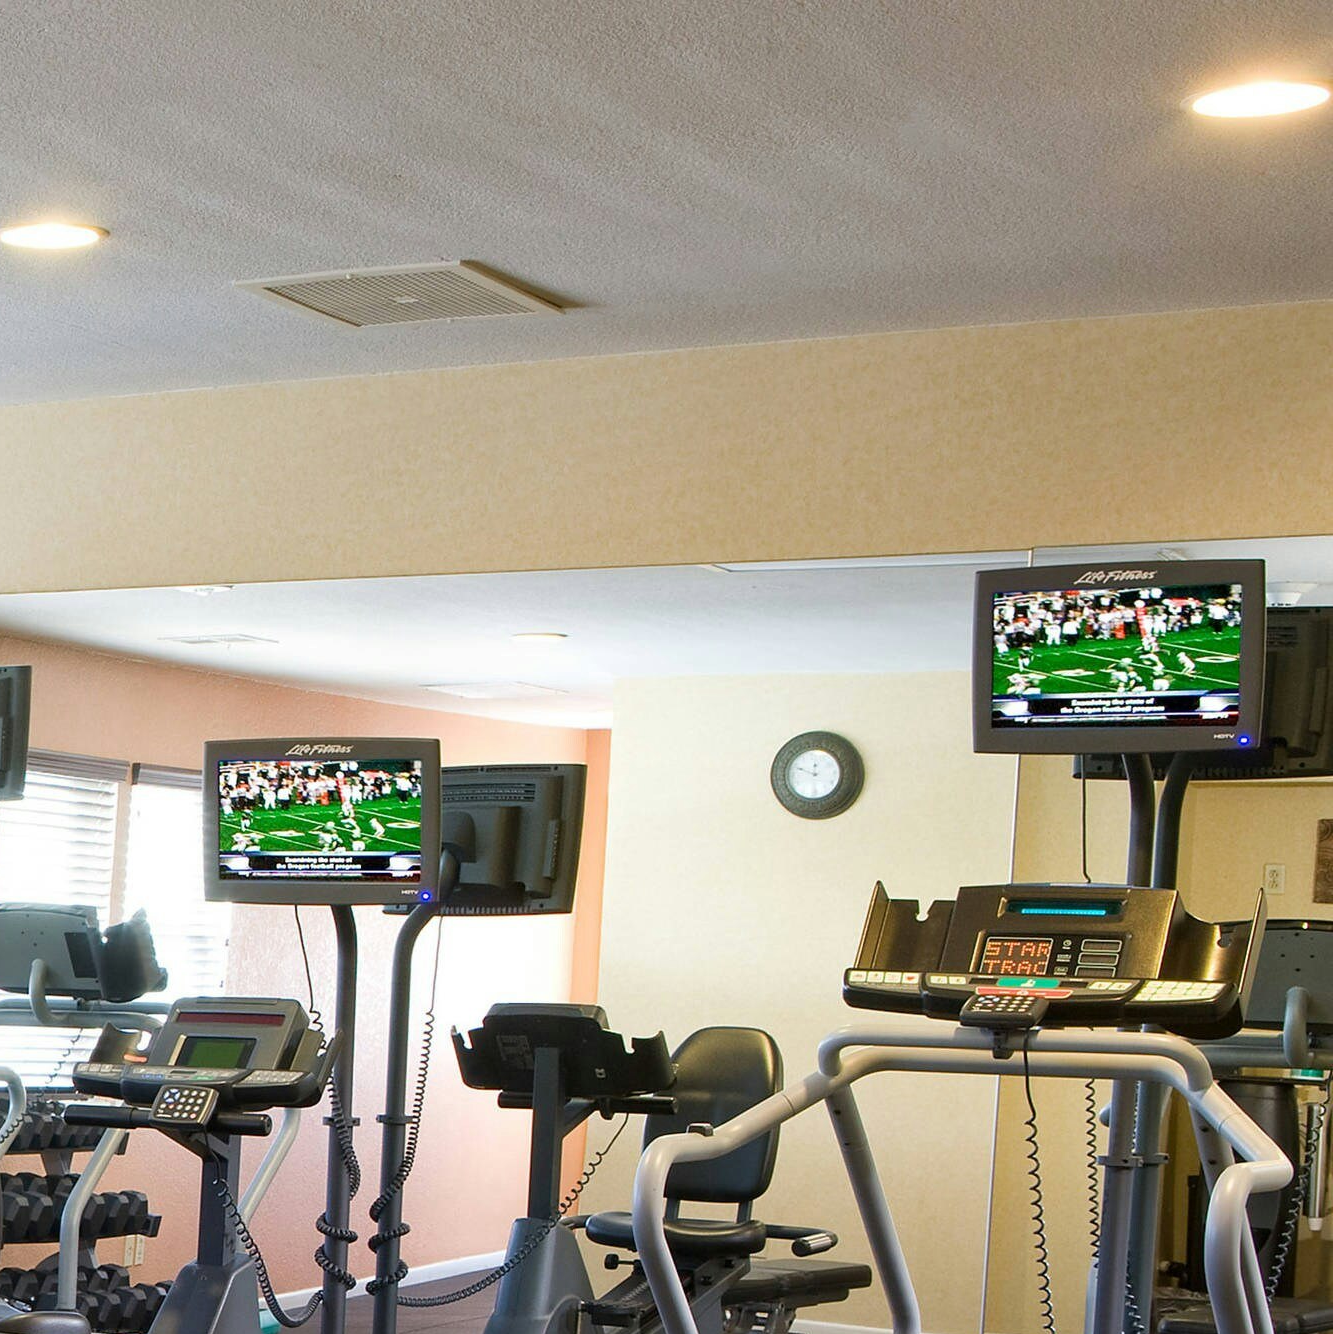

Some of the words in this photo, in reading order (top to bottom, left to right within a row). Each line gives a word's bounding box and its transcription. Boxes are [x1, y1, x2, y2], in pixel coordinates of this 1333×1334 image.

[1073, 570, 1106, 585] Life
[1102, 570, 1158, 584] Fitness
[285, 744, 311, 756] Life
[309, 744, 354, 756] Fitness
[985, 941, 1051, 957] STAR
[983, 960, 1047, 976] TRAC
